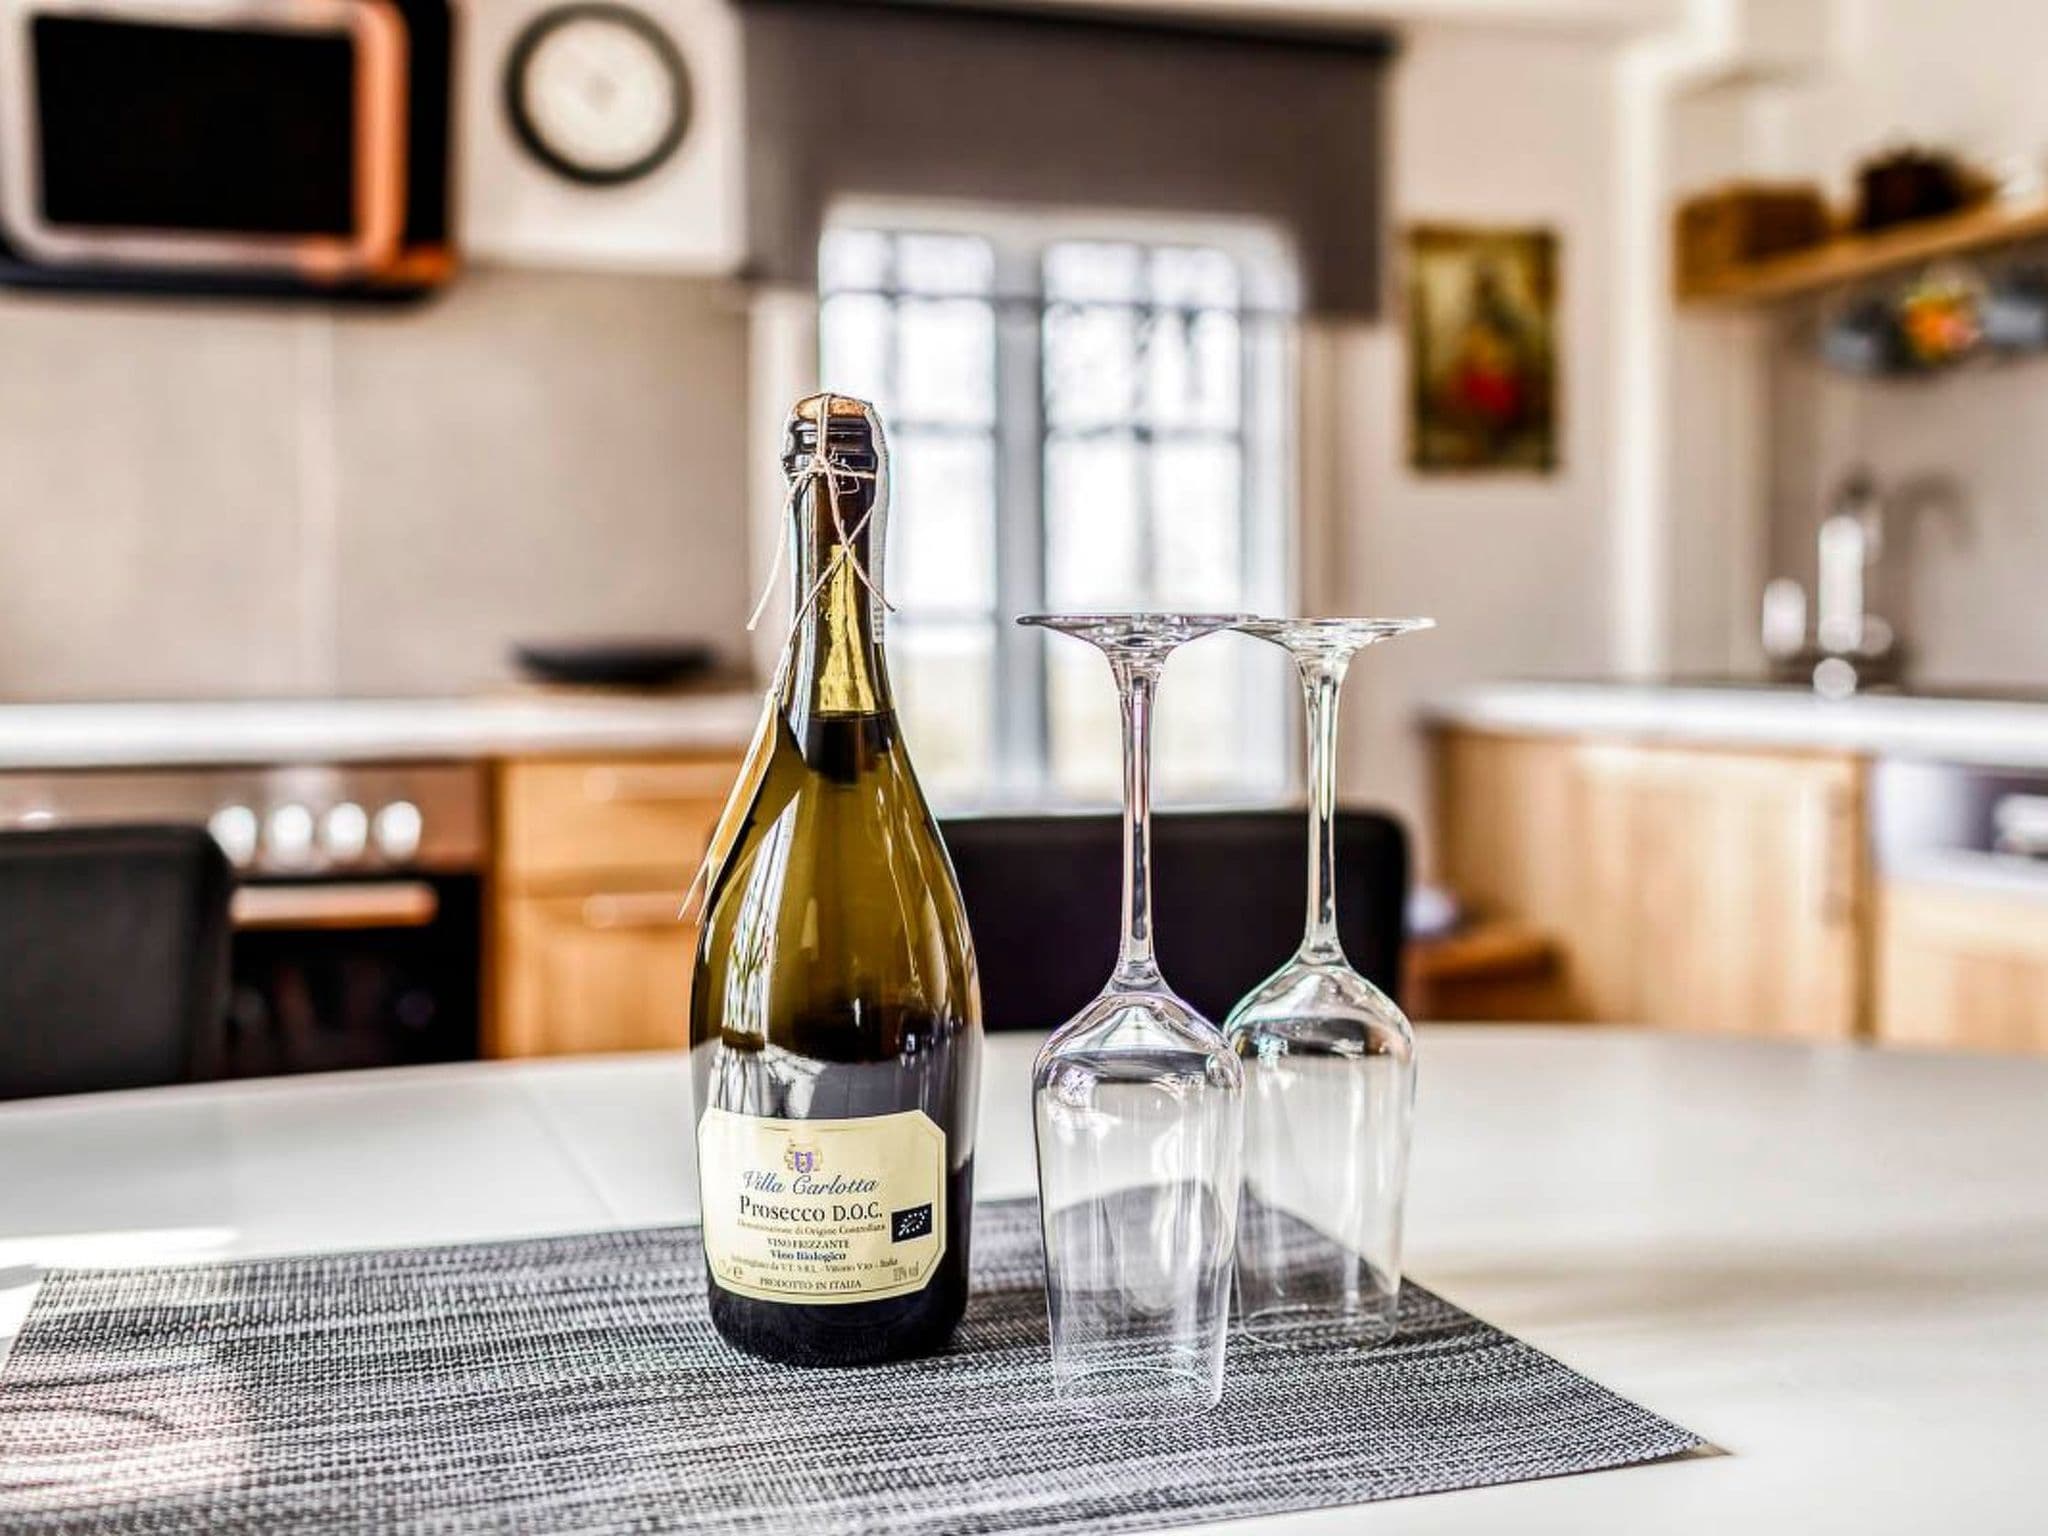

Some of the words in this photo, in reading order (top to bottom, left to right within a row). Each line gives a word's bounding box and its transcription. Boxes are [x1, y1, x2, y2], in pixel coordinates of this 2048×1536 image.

[743, 1171, 785, 1193] Villa
[792, 1174, 879, 1195] Carlotta
[740, 1195, 826, 1222] Prosecco
[832, 1201, 883, 1222] D.O.C.
[805, 1225, 837, 1237] Origine
[767, 1238, 792, 1249] VINO
[793, 1239, 850, 1250] FRIZZANTE
[771, 1250, 794, 1261] Vino
[796, 1251, 847, 1262] Biologico
[760, 1277, 813, 1290] PRODOTTO
[814, 1280, 829, 1290] IN
[829, 1278, 862, 1290] ITALIA
